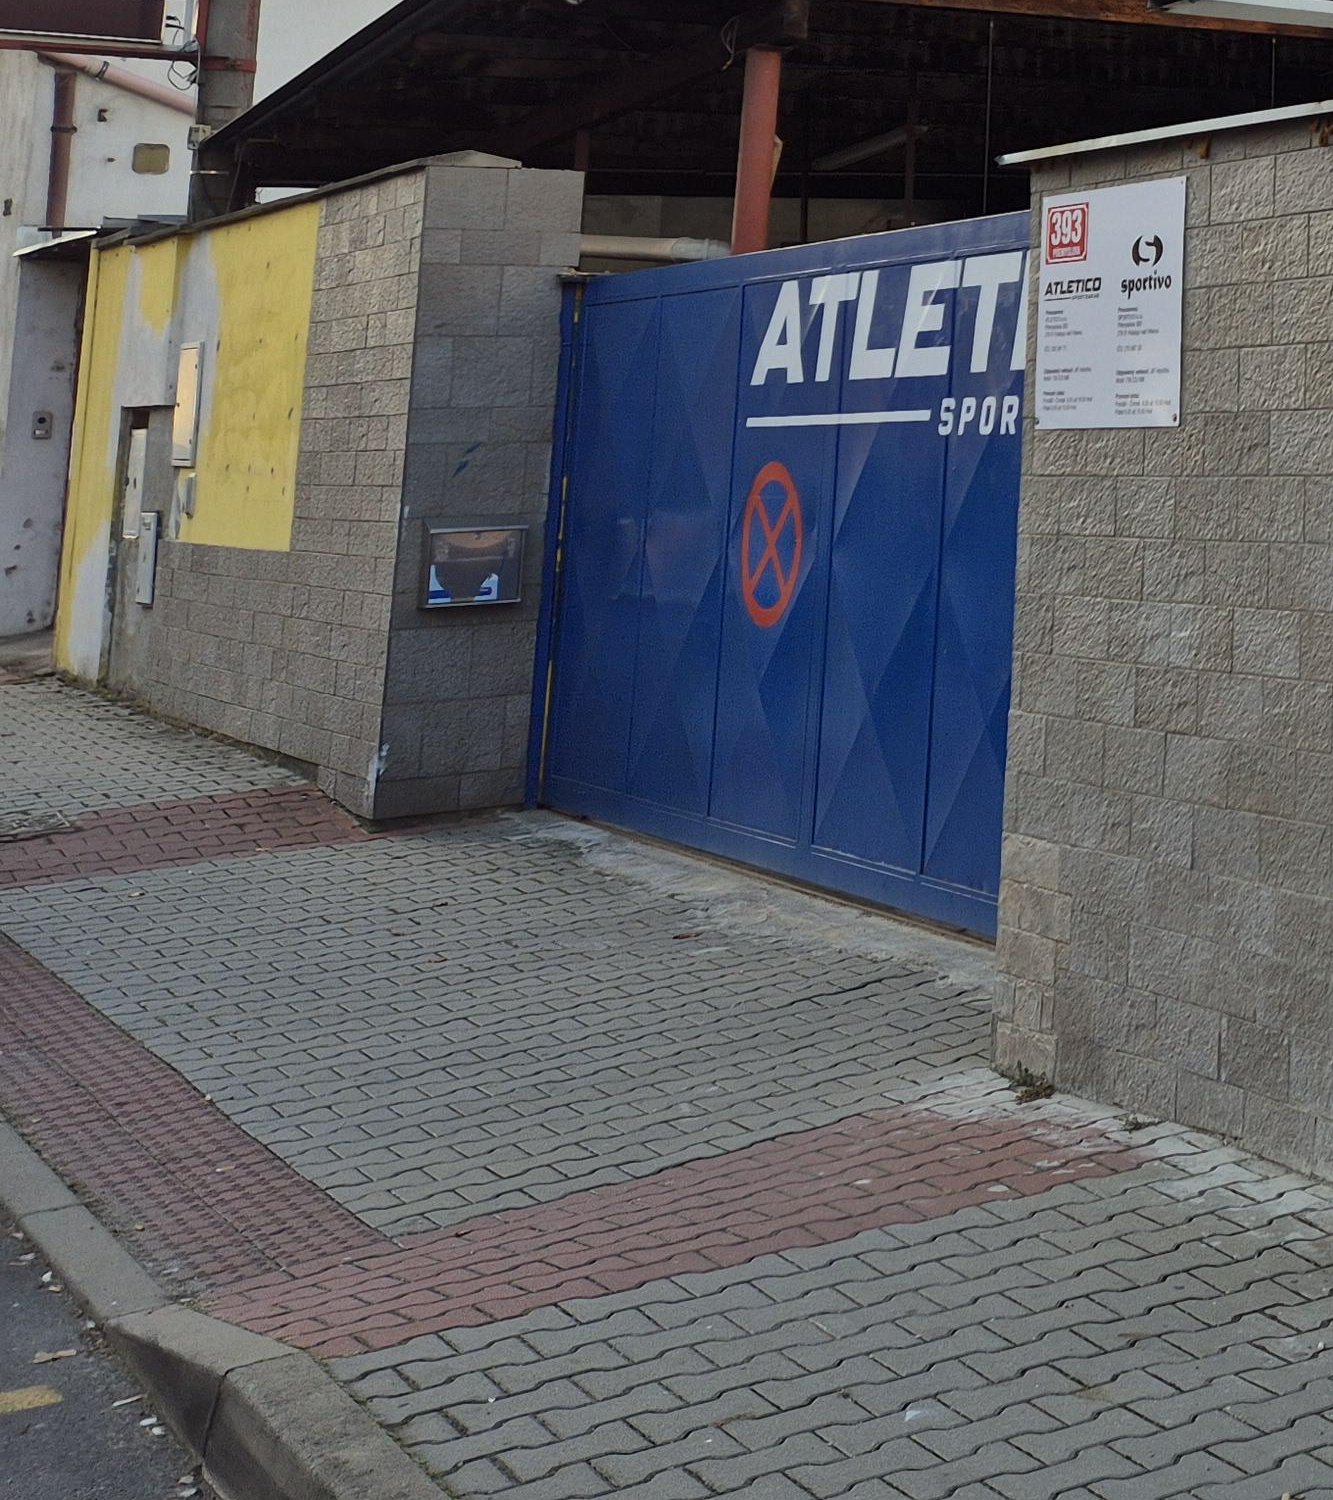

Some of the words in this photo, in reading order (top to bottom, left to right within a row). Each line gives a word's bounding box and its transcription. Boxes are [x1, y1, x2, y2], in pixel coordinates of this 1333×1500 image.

[1050, 209, 1083, 246] 393
[1044, 277, 1102, 296] ATLETICO
[1120, 269, 1172, 300] sportivo
